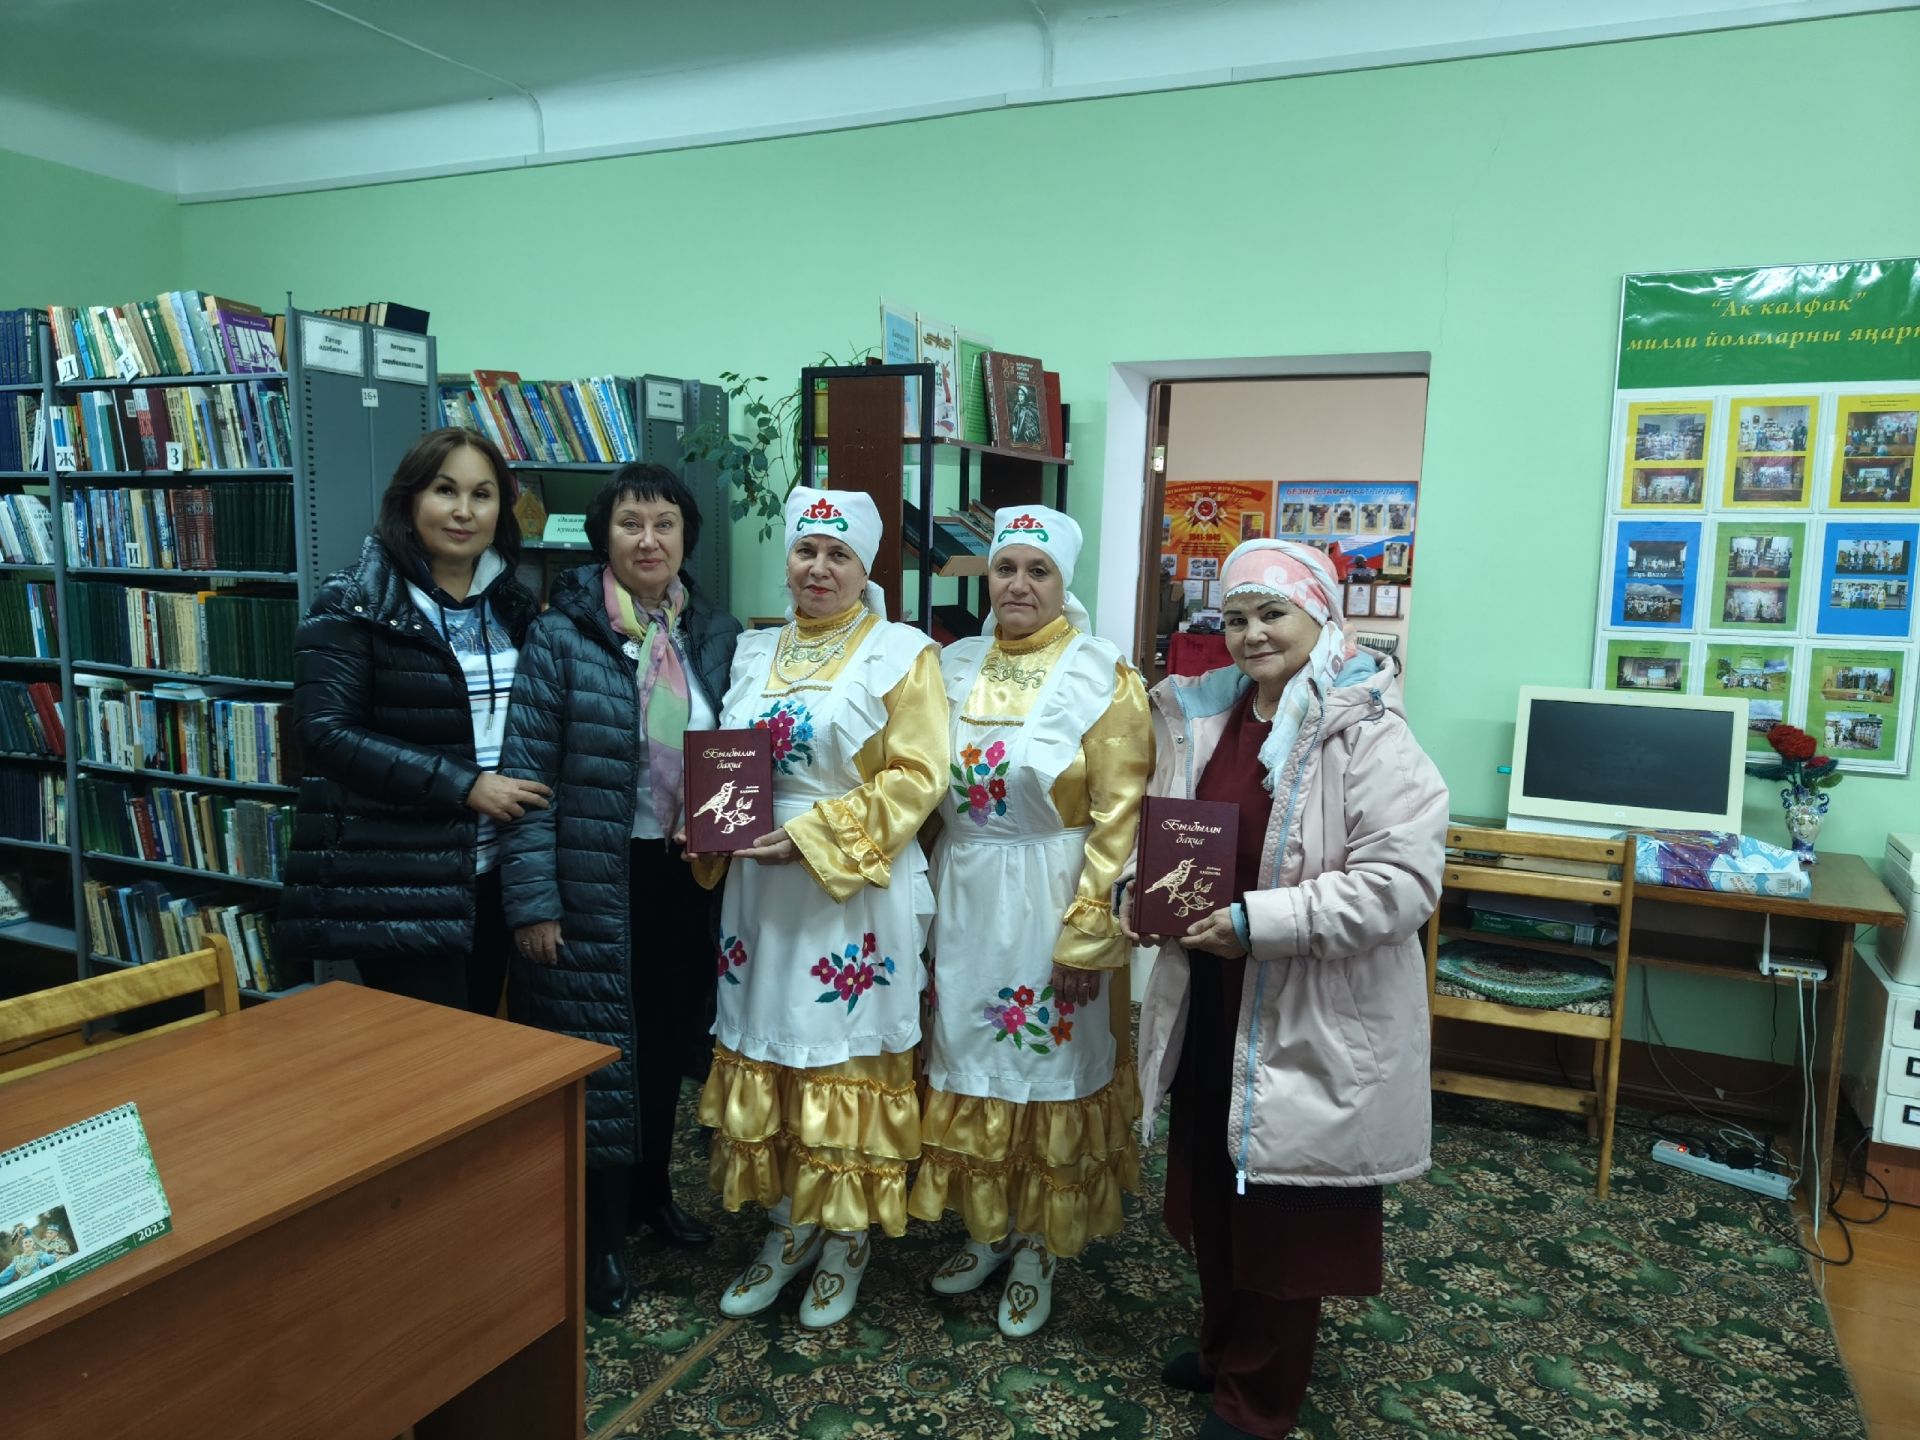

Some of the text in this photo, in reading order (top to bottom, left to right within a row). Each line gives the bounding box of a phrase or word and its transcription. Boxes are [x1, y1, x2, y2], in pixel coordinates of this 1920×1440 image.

[1627, 337, 1697, 351] милли
[1705, 330, 1841, 349] йолаларны
[63, 362, 79, 381] Д
[123, 357, 133, 373] Е
[363, 392, 377, 400] 16+
[57, 453, 75, 467] Ж
[129, 548, 138, 564] И
[137, 1222, 166, 1242] 2023
